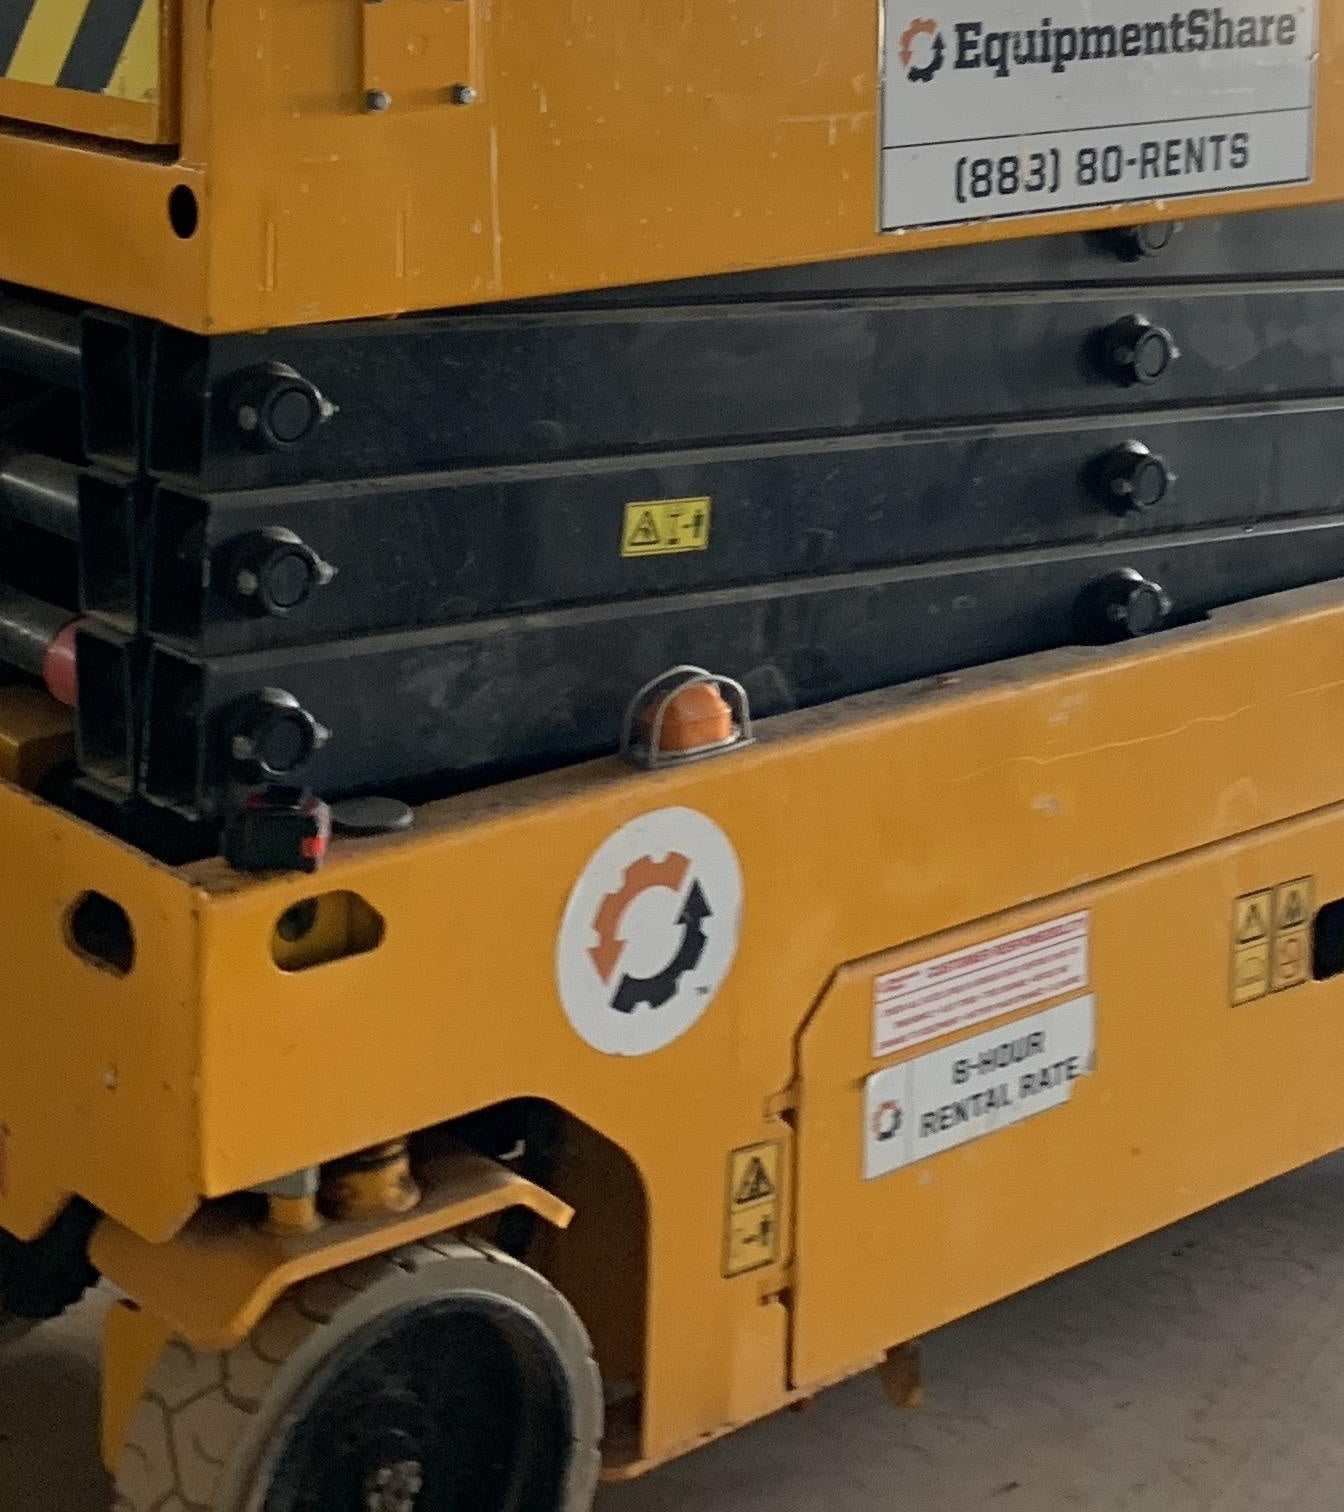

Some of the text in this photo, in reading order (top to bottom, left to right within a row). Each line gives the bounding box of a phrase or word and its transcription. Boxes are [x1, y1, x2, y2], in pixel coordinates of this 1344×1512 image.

[953, 7, 1297, 78] EquipmentShare
[954, 131, 1250, 204] (883) 80-RENTS
[919, 1055, 1080, 1138] RENTAL RATE
